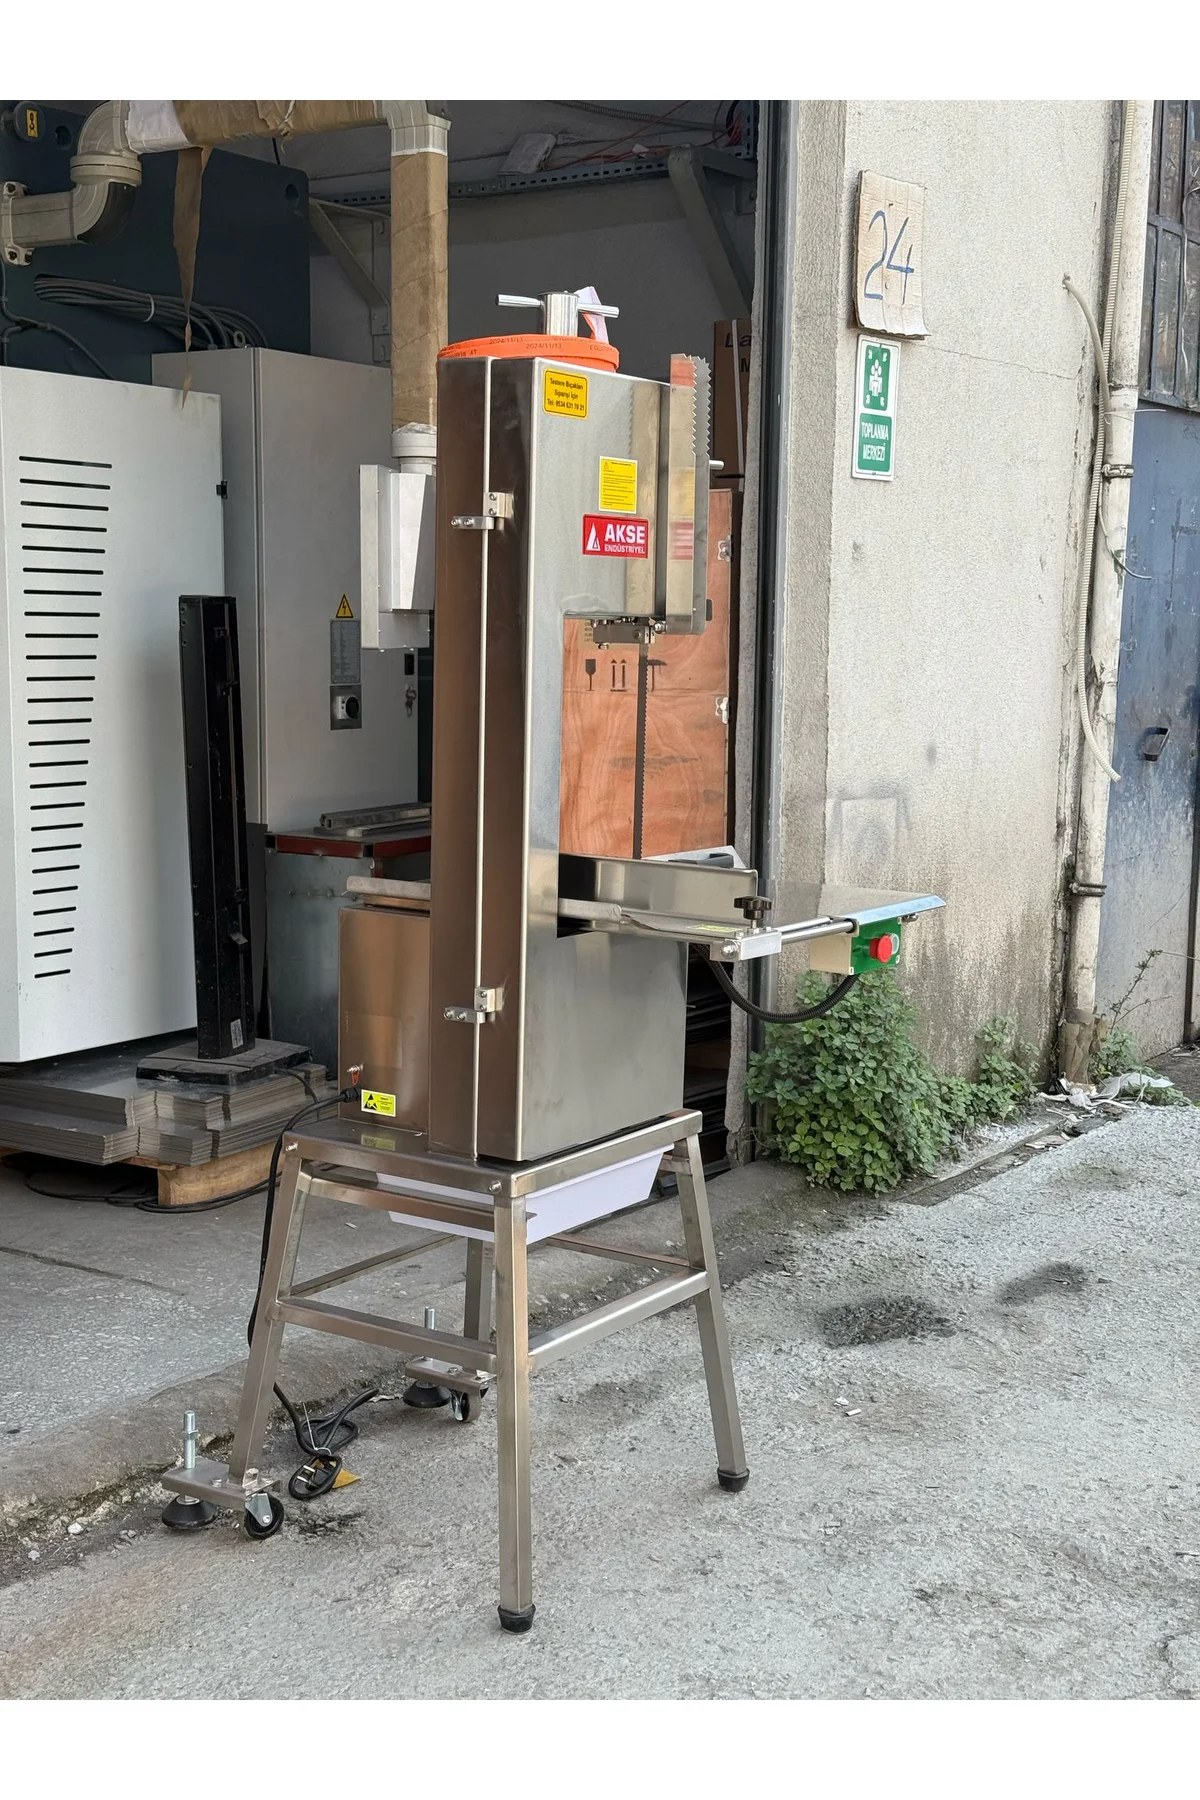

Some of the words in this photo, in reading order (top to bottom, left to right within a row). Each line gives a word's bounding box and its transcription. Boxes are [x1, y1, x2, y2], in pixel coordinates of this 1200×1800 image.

[864, 210, 914, 305] 24
[861, 422, 889, 440] TOPLANMA
[862, 442, 886, 462] MERKEZİ
[604, 523, 646, 544] AKSE
[604, 543, 646, 554] ENDÜSTRİYEL
